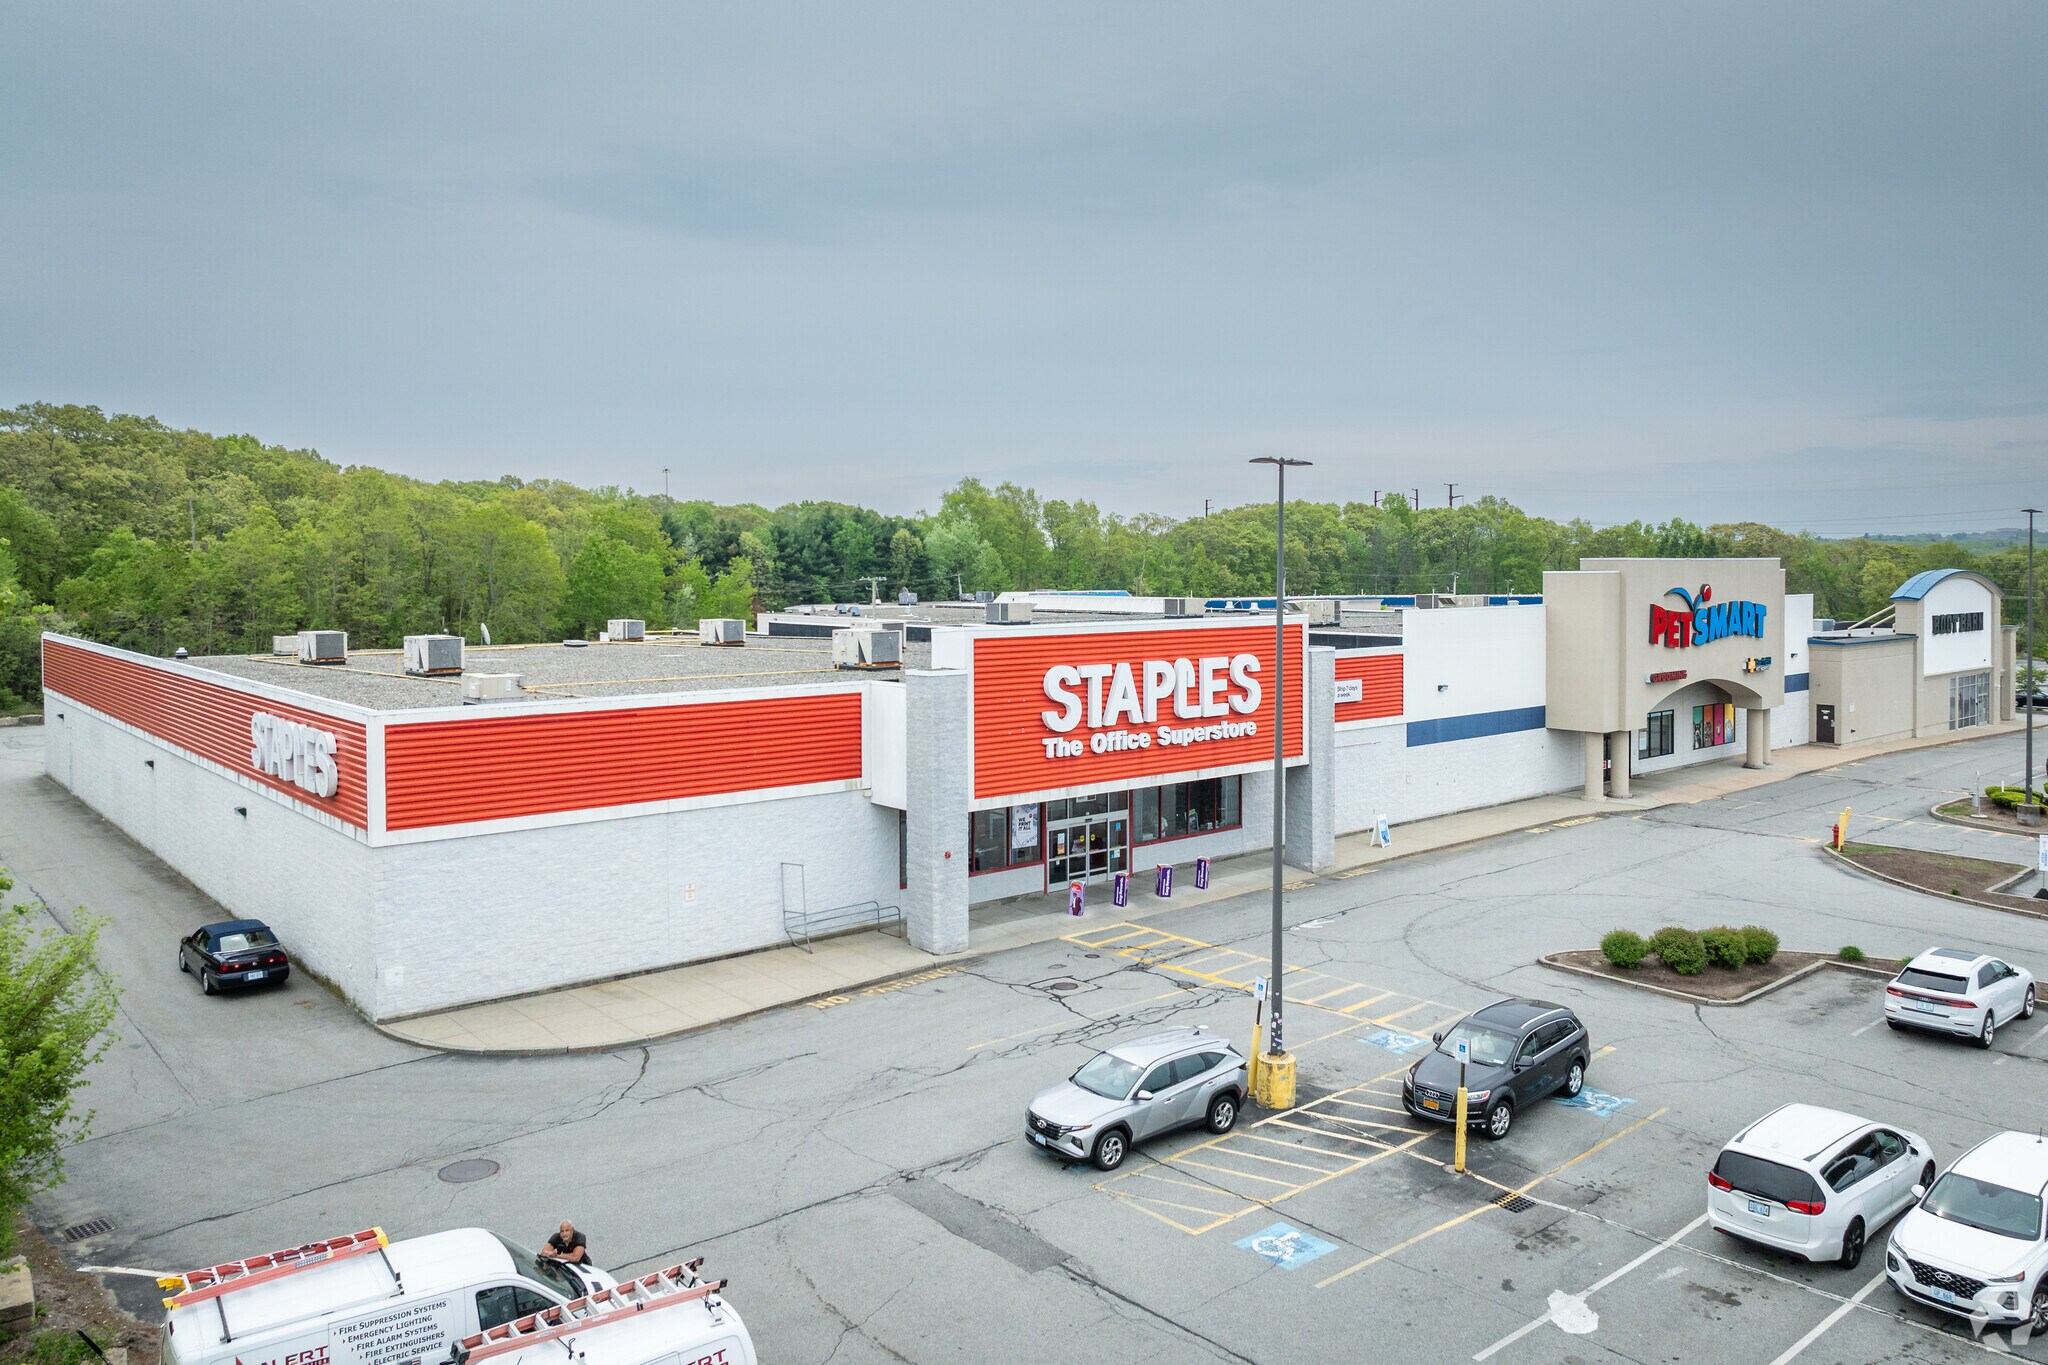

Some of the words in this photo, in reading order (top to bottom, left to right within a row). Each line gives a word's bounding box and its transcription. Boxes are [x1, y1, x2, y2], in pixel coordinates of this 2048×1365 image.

[1649, 601, 1767, 647] PETSMART
[1932, 614, 1959, 635] BOOT
[1959, 612, 1984, 633] BARN
[1650, 669, 1688, 683] GROOMING
[1041, 653, 1262, 733] STAPLES
[251, 711, 338, 798] STAPLES
[1042, 737, 1084, 759] The
[1090, 730, 1151, 754] Office
[1157, 721, 1257, 747] Superstore
[339, 1325, 357, 1336] FIRE
[359, 1310, 412, 1330] SUPPRESSION
[413, 1301, 447, 1316] SYSTEMS
[348, 1325, 394, 1343] EMERGENCY
[396, 1314, 433, 1330] LIGHTING
[356, 1340, 375, 1351] FIRE
[376, 1333, 402, 1345] ALARM
[404, 1323, 438, 1338] SYSTEMS
[365, 1348, 383, 1359] FIRE
[385, 1331, 445, 1352] EXTINGUISHERS
[373, 1351, 410, 1365] ELECTRIC
[411, 1341, 443, 1357] SERVICE
